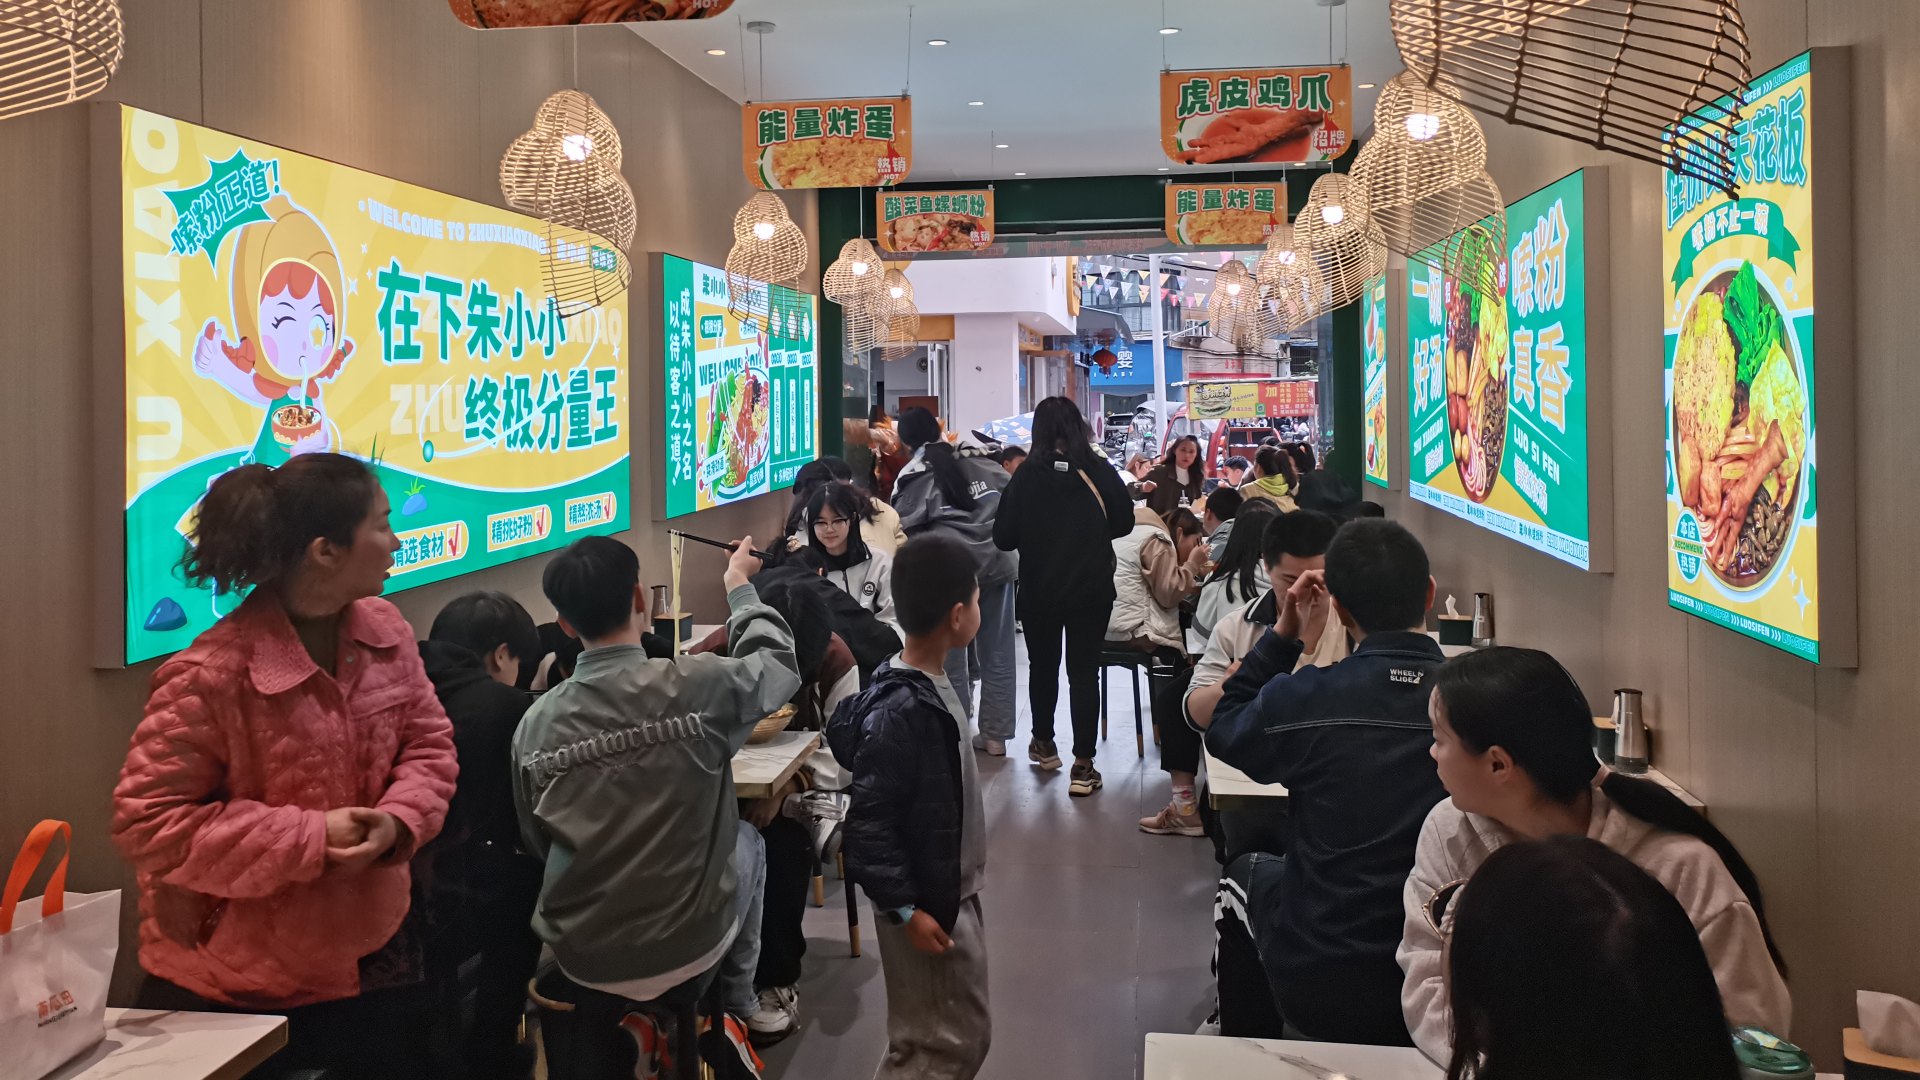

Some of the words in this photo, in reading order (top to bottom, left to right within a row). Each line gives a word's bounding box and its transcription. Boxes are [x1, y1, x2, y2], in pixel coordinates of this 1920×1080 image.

[1176, 72, 1332, 118] 虎皮鸡爪
[757, 104, 895, 147] 能量炸蛋
[1313, 130, 1345, 148] 招牌
[877, 156, 905, 173] 热销
[884, 194, 986, 222] 酸菜鱼螺蛳粉
[1176, 187, 1275, 215] 能量炸蛋
[367, 198, 443, 239] WELCOME
[446, 221, 465, 241] TO
[1691, 202, 1770, 251] 嗦粉不止一碗
[1511, 197, 1570, 318] 嗦粉
[376, 255, 567, 364] 在下朱小小
[1265, 386, 1278, 398] 加
[1512, 320, 1575, 435] 真香
[463, 366, 619, 453] 终极分量王
[1514, 424, 1528, 454] LUO
[1531, 440, 1539, 466] SI
[1542, 450, 1559, 485] FEN
[491, 515, 533, 545] 精挑好粉
[568, 499, 602, 525] 精熬浓汤
[1680, 520, 1696, 540] 本店
[1670, 591, 1695, 608] LUOSIFEN
[1740, 617, 1771, 638] LUOSIFEN
[1390, 668, 1417, 677] WHEEL
[1390, 675, 1414, 683] SLIDE
